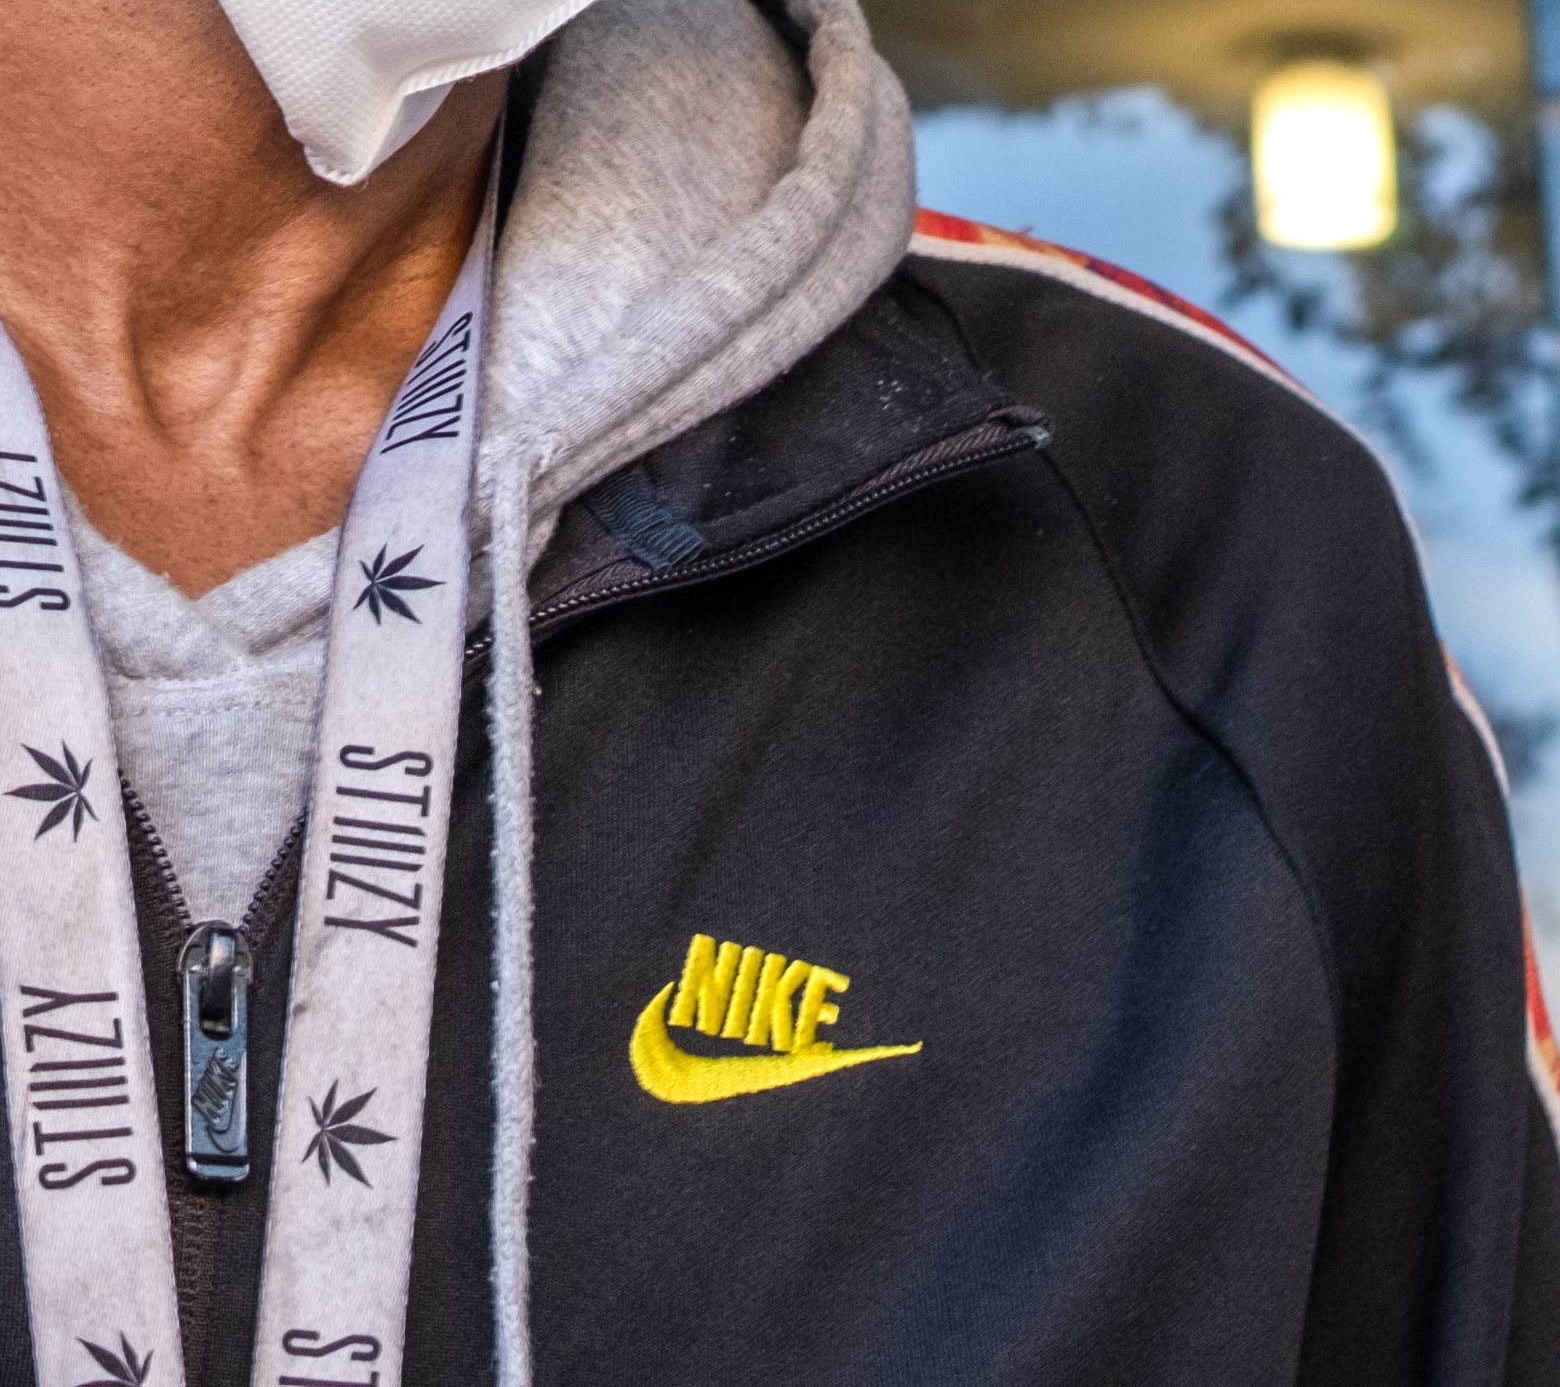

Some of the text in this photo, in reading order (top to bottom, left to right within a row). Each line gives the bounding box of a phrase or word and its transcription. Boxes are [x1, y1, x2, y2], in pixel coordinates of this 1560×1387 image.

[380, 311, 473, 455] STIIIZY
[324, 743, 434, 949] STIIIZY
[667, 933, 850, 1054] NIKE
[19, 984, 138, 1191] STIIIZY
